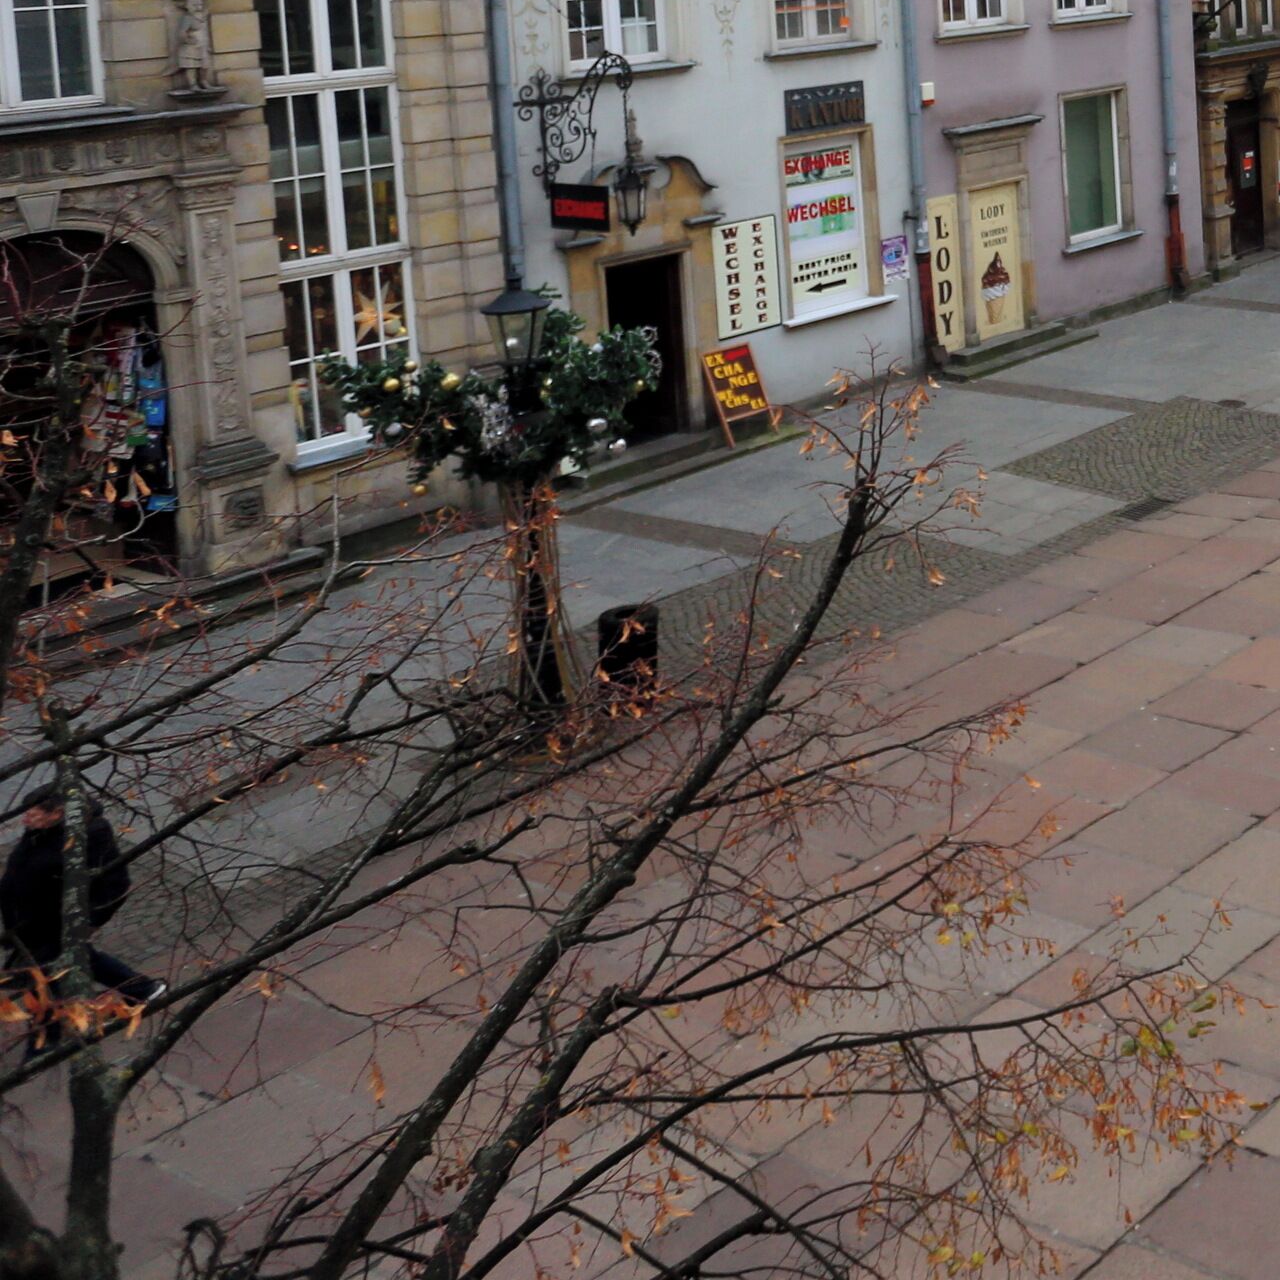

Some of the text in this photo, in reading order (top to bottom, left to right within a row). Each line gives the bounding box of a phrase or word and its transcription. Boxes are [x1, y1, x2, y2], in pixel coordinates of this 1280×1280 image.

[784, 150, 850, 176] EXCHANGE
[787, 196, 855, 223] WECHSEL
[980, 202, 1005, 220] LODY
[751, 222, 768, 324] EXCHANGE
[798, 252, 852, 272] BEST PRICE
[721, 226, 742, 331] WECHSEL
[934, 215, 954, 337] LODY
